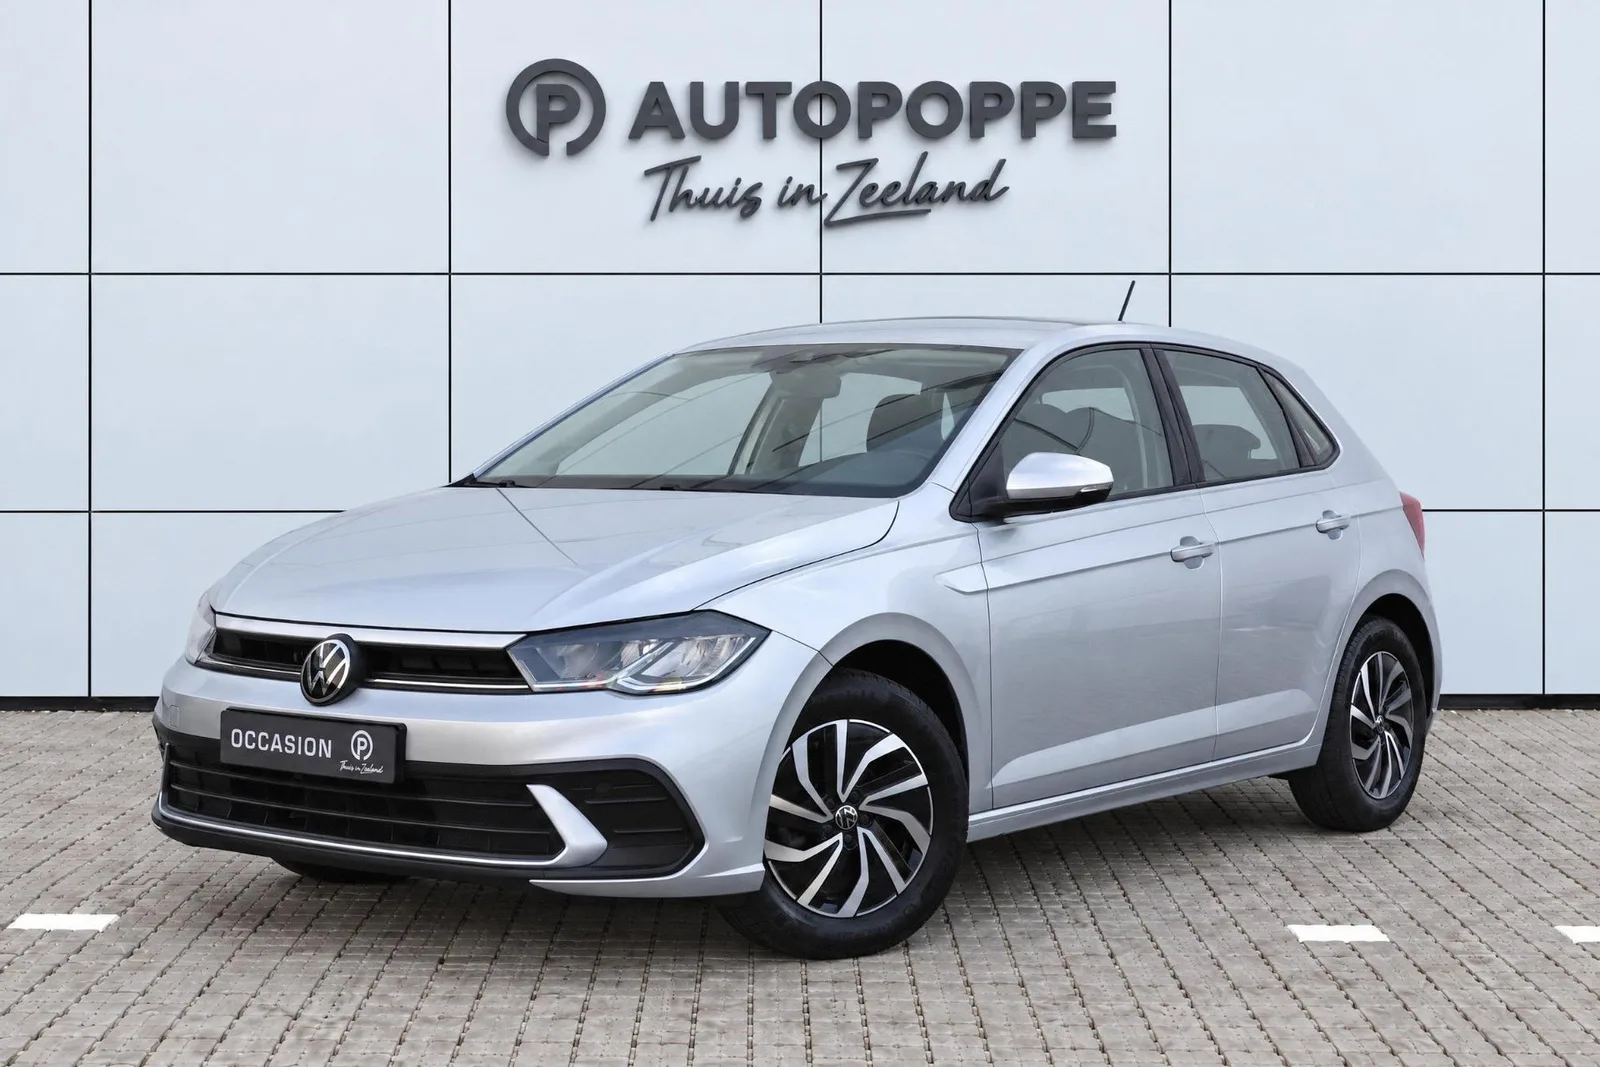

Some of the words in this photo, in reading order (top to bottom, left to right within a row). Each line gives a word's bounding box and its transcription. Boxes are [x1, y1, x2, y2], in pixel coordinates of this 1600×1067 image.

[628, 80, 1117, 140] AUTOPOPPE
[644, 155, 764, 222] Thuis
[777, 175, 827, 209] in
[823, 151, 1011, 227] Zeeland
[231, 728, 332, 758] OCCASION
